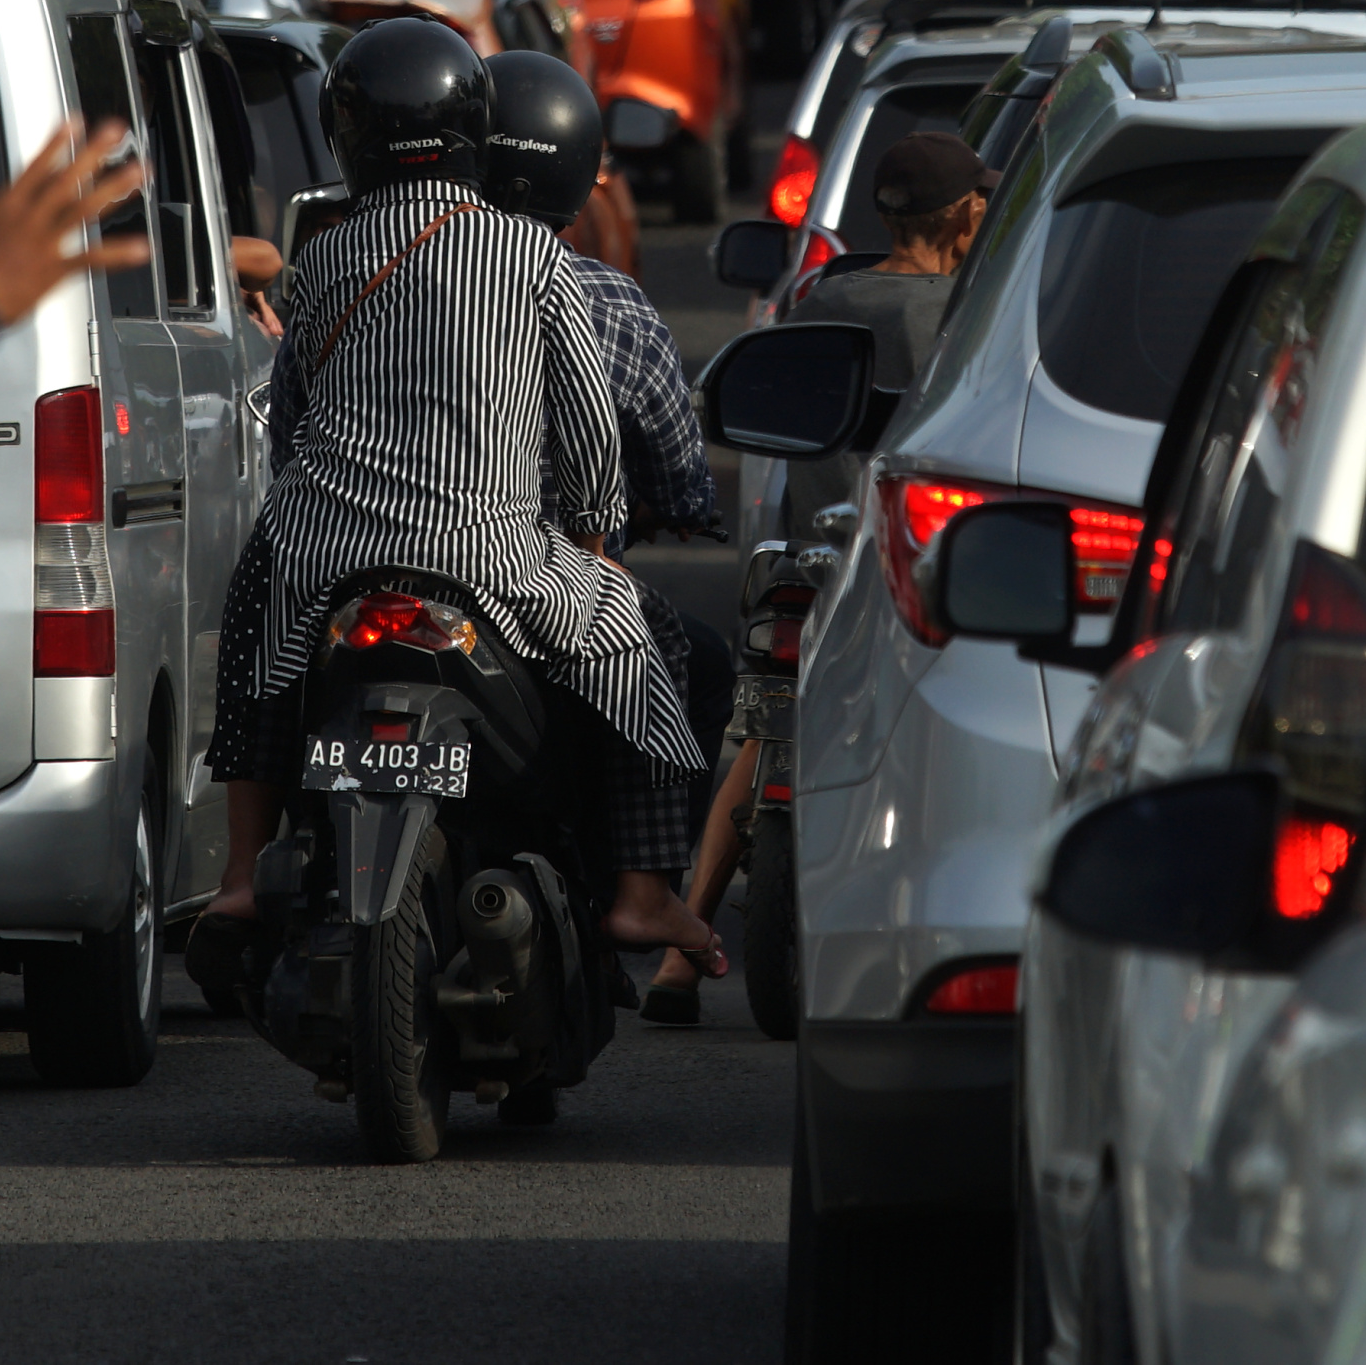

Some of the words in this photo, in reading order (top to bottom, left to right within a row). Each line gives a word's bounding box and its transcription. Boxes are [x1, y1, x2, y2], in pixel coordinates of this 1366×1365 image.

[389, 138, 444, 151] HONDA
[309, 740, 345, 767] AB
[360, 744, 419, 769] 4103
[429, 746, 466, 772] JB
